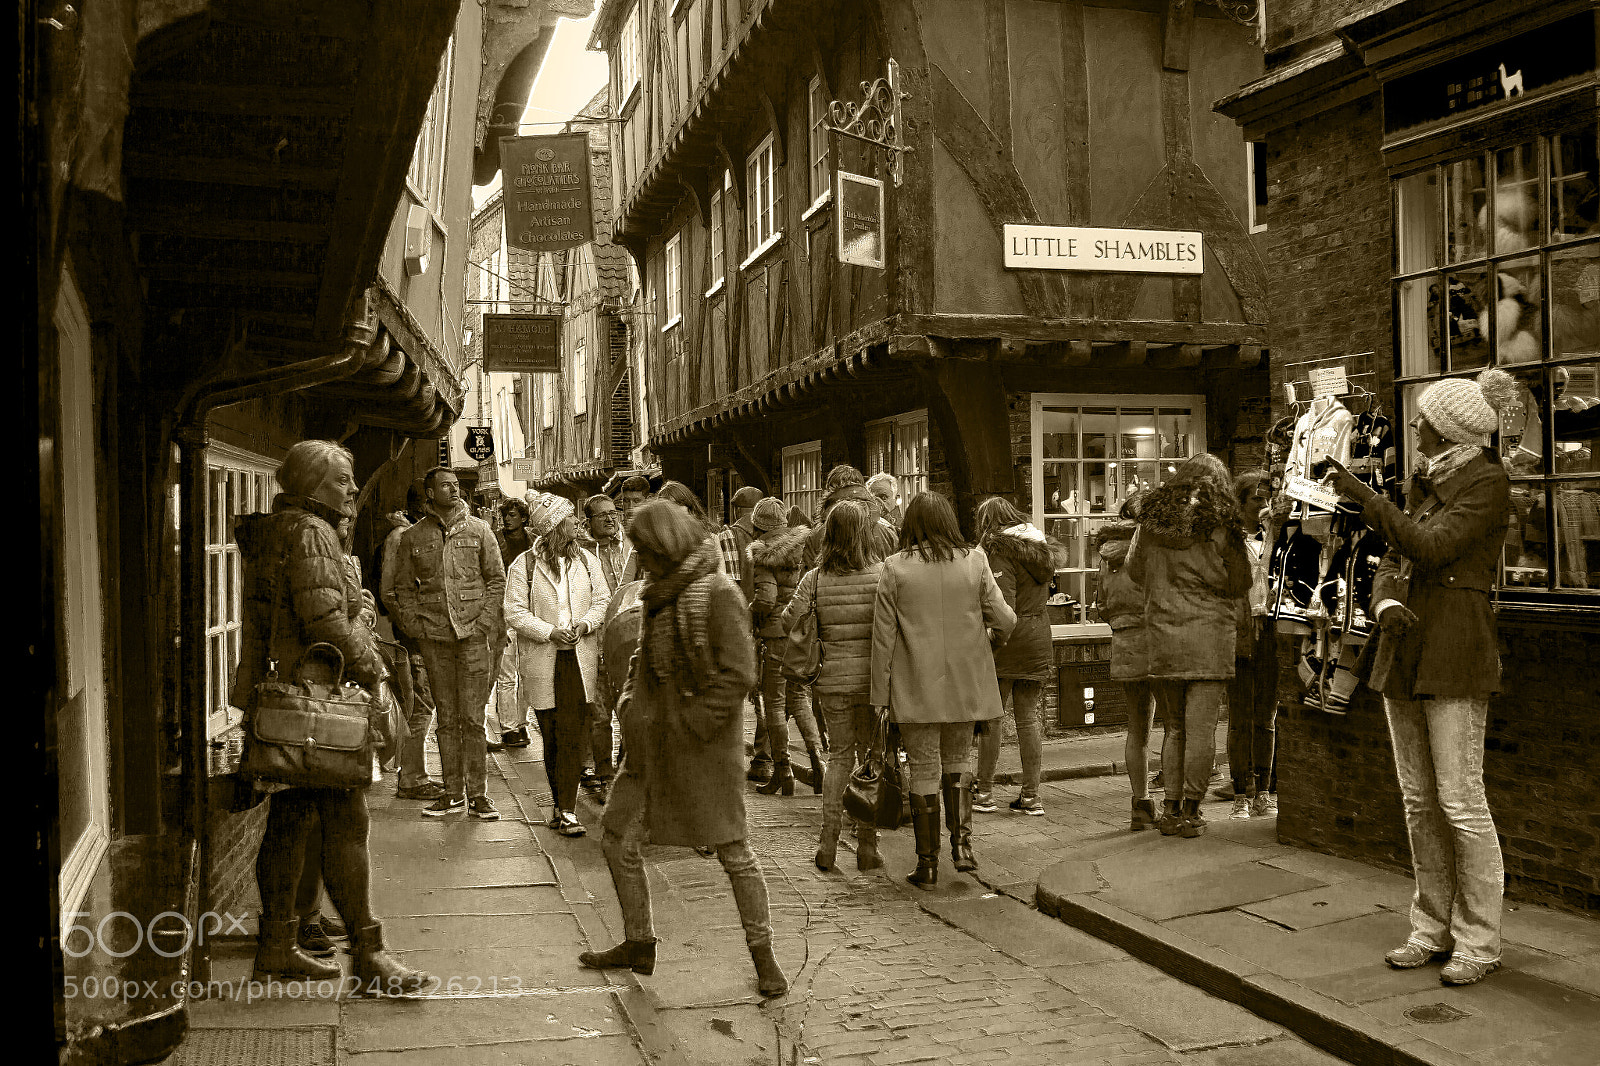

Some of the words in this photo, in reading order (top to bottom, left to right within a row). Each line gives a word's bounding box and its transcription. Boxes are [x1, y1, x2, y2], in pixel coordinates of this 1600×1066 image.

[522, 163, 549, 175] MONK
[552, 161, 572, 174] BAR
[514, 174, 580, 187] CHOCOLATIERS
[517, 197, 582, 212] Handmade
[531, 215, 571, 228] Artisan
[520, 230, 585, 244] Chocolates
[1012, 236, 1078, 258] LITTLE
[1094, 239, 1197, 262] SHAMBLES
